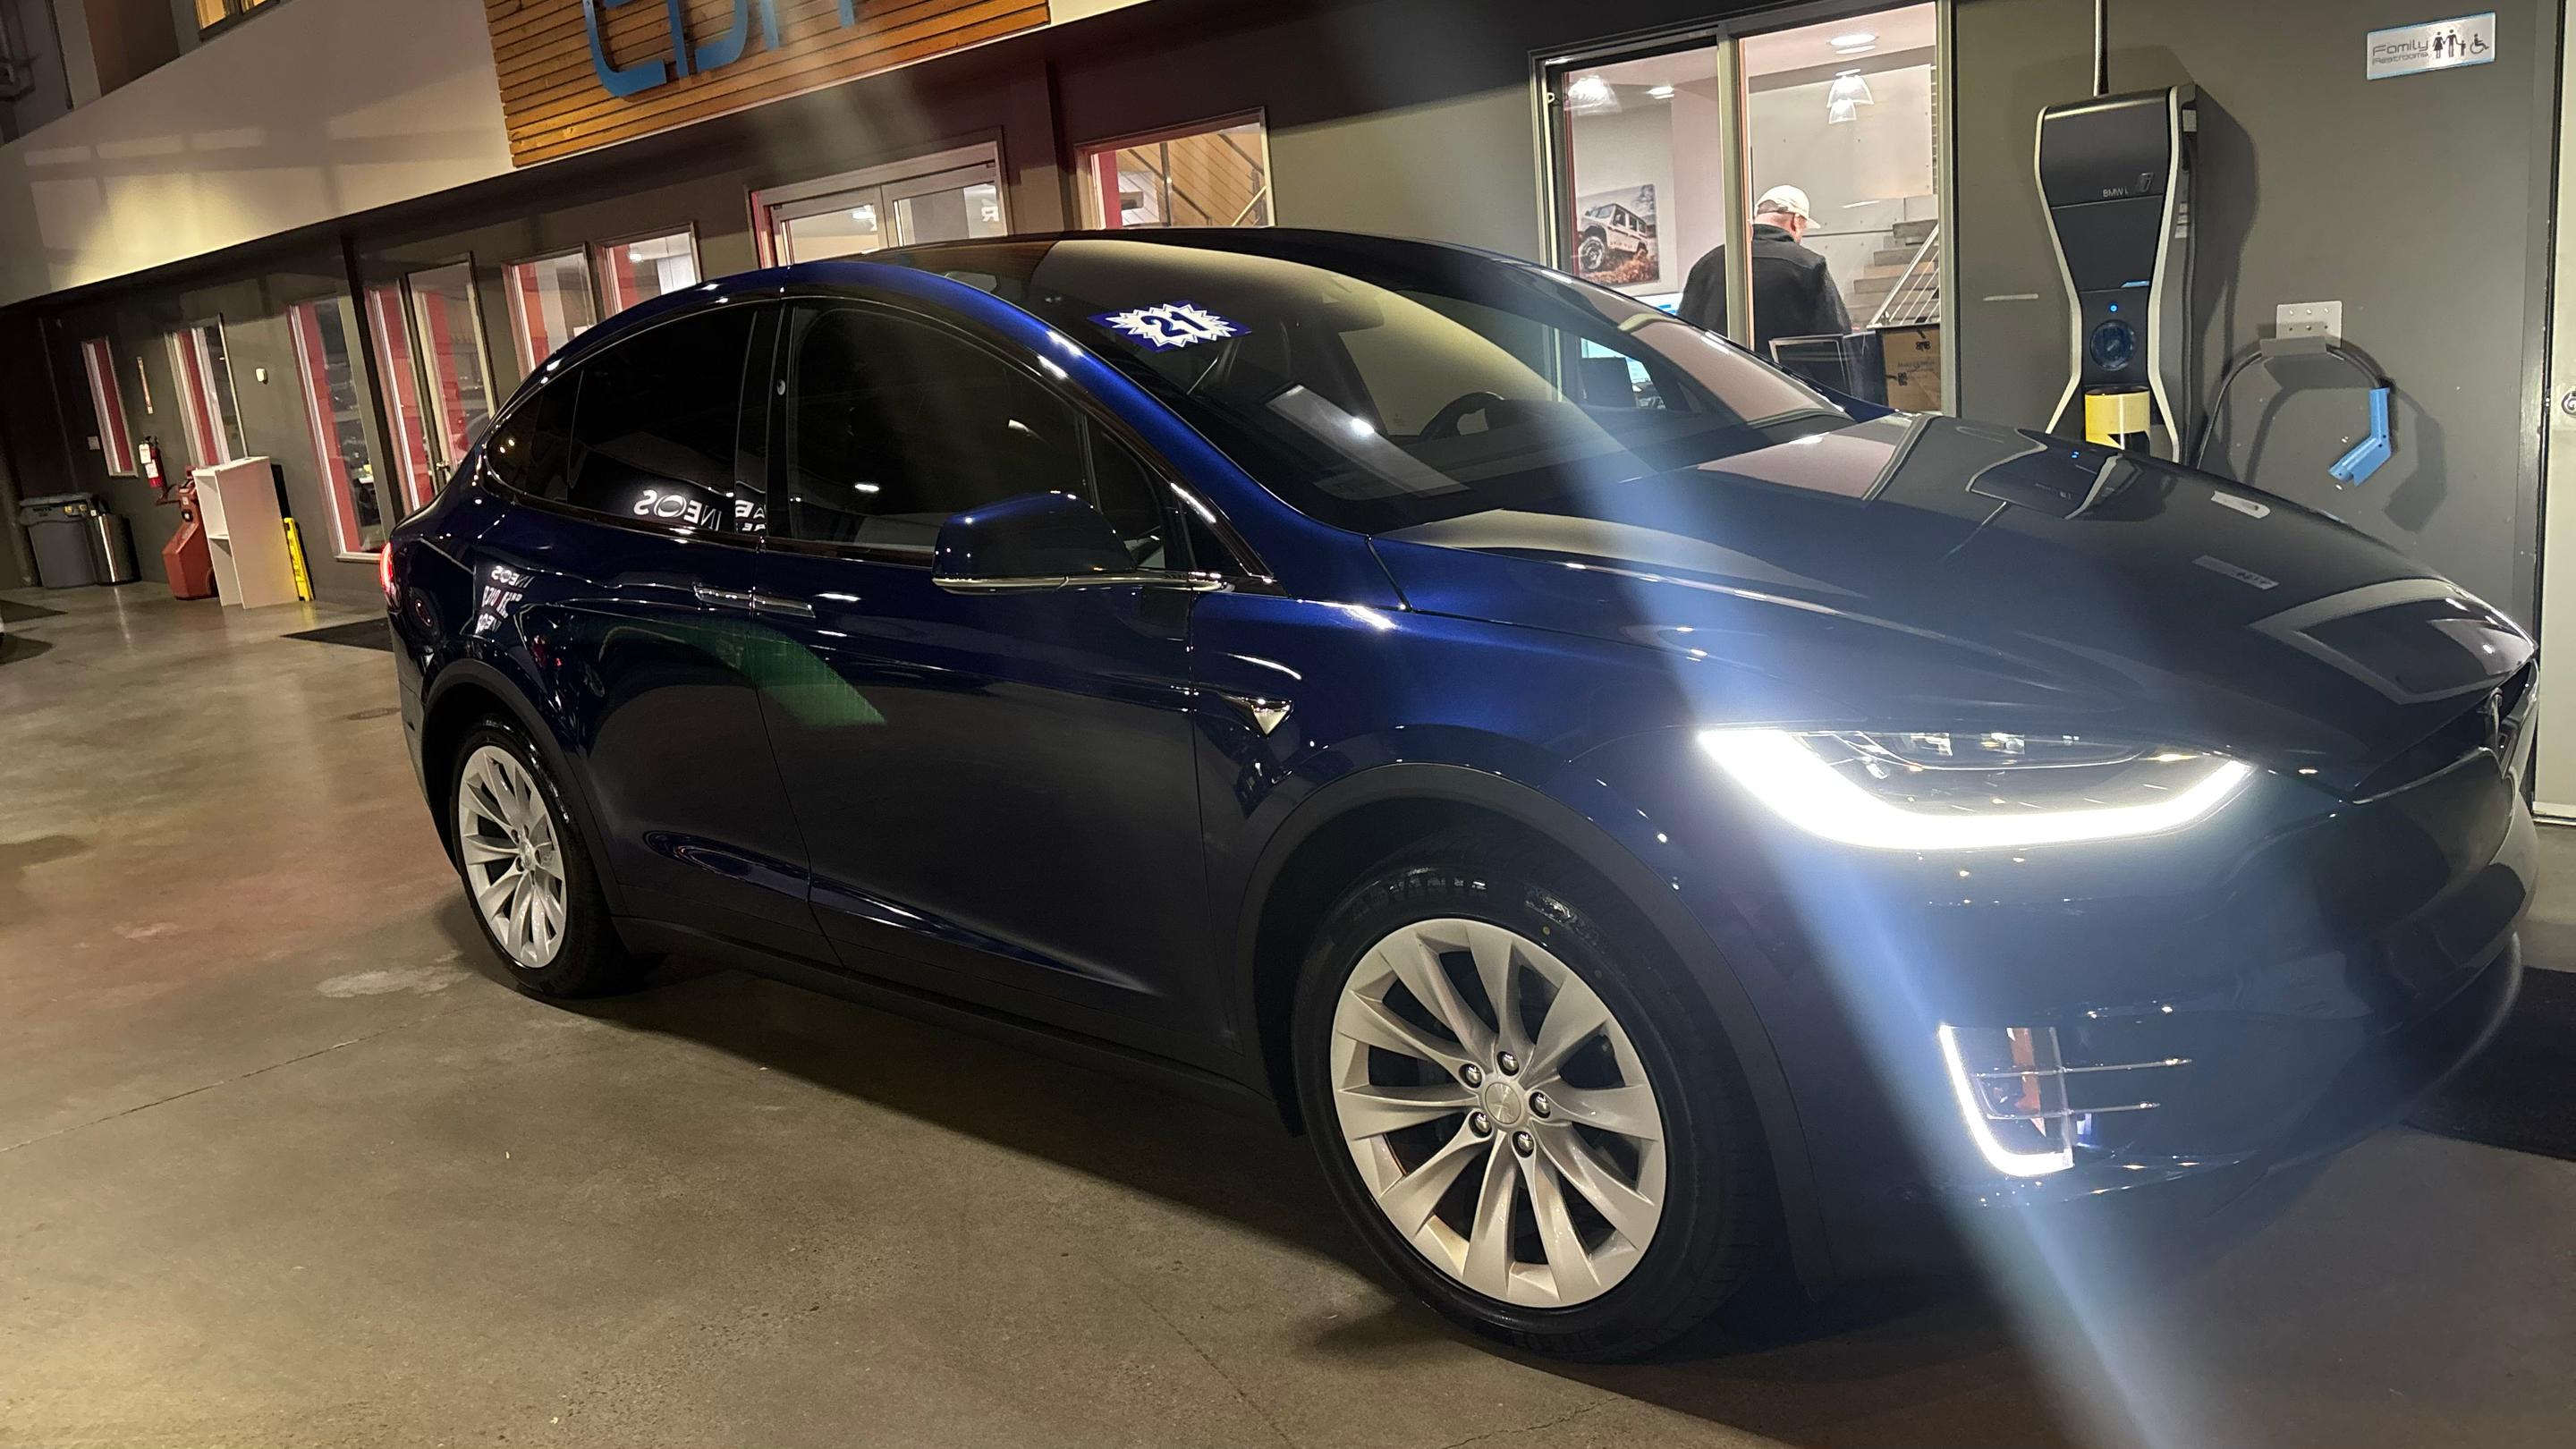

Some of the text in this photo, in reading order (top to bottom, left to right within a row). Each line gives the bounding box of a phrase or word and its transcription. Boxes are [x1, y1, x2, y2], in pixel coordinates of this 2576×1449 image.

[2372, 38, 2428, 56] Family
[2372, 51, 2428, 64] Restrooms
[2103, 187, 2123, 198] BMW
[1140, 311, 1210, 338] 21
